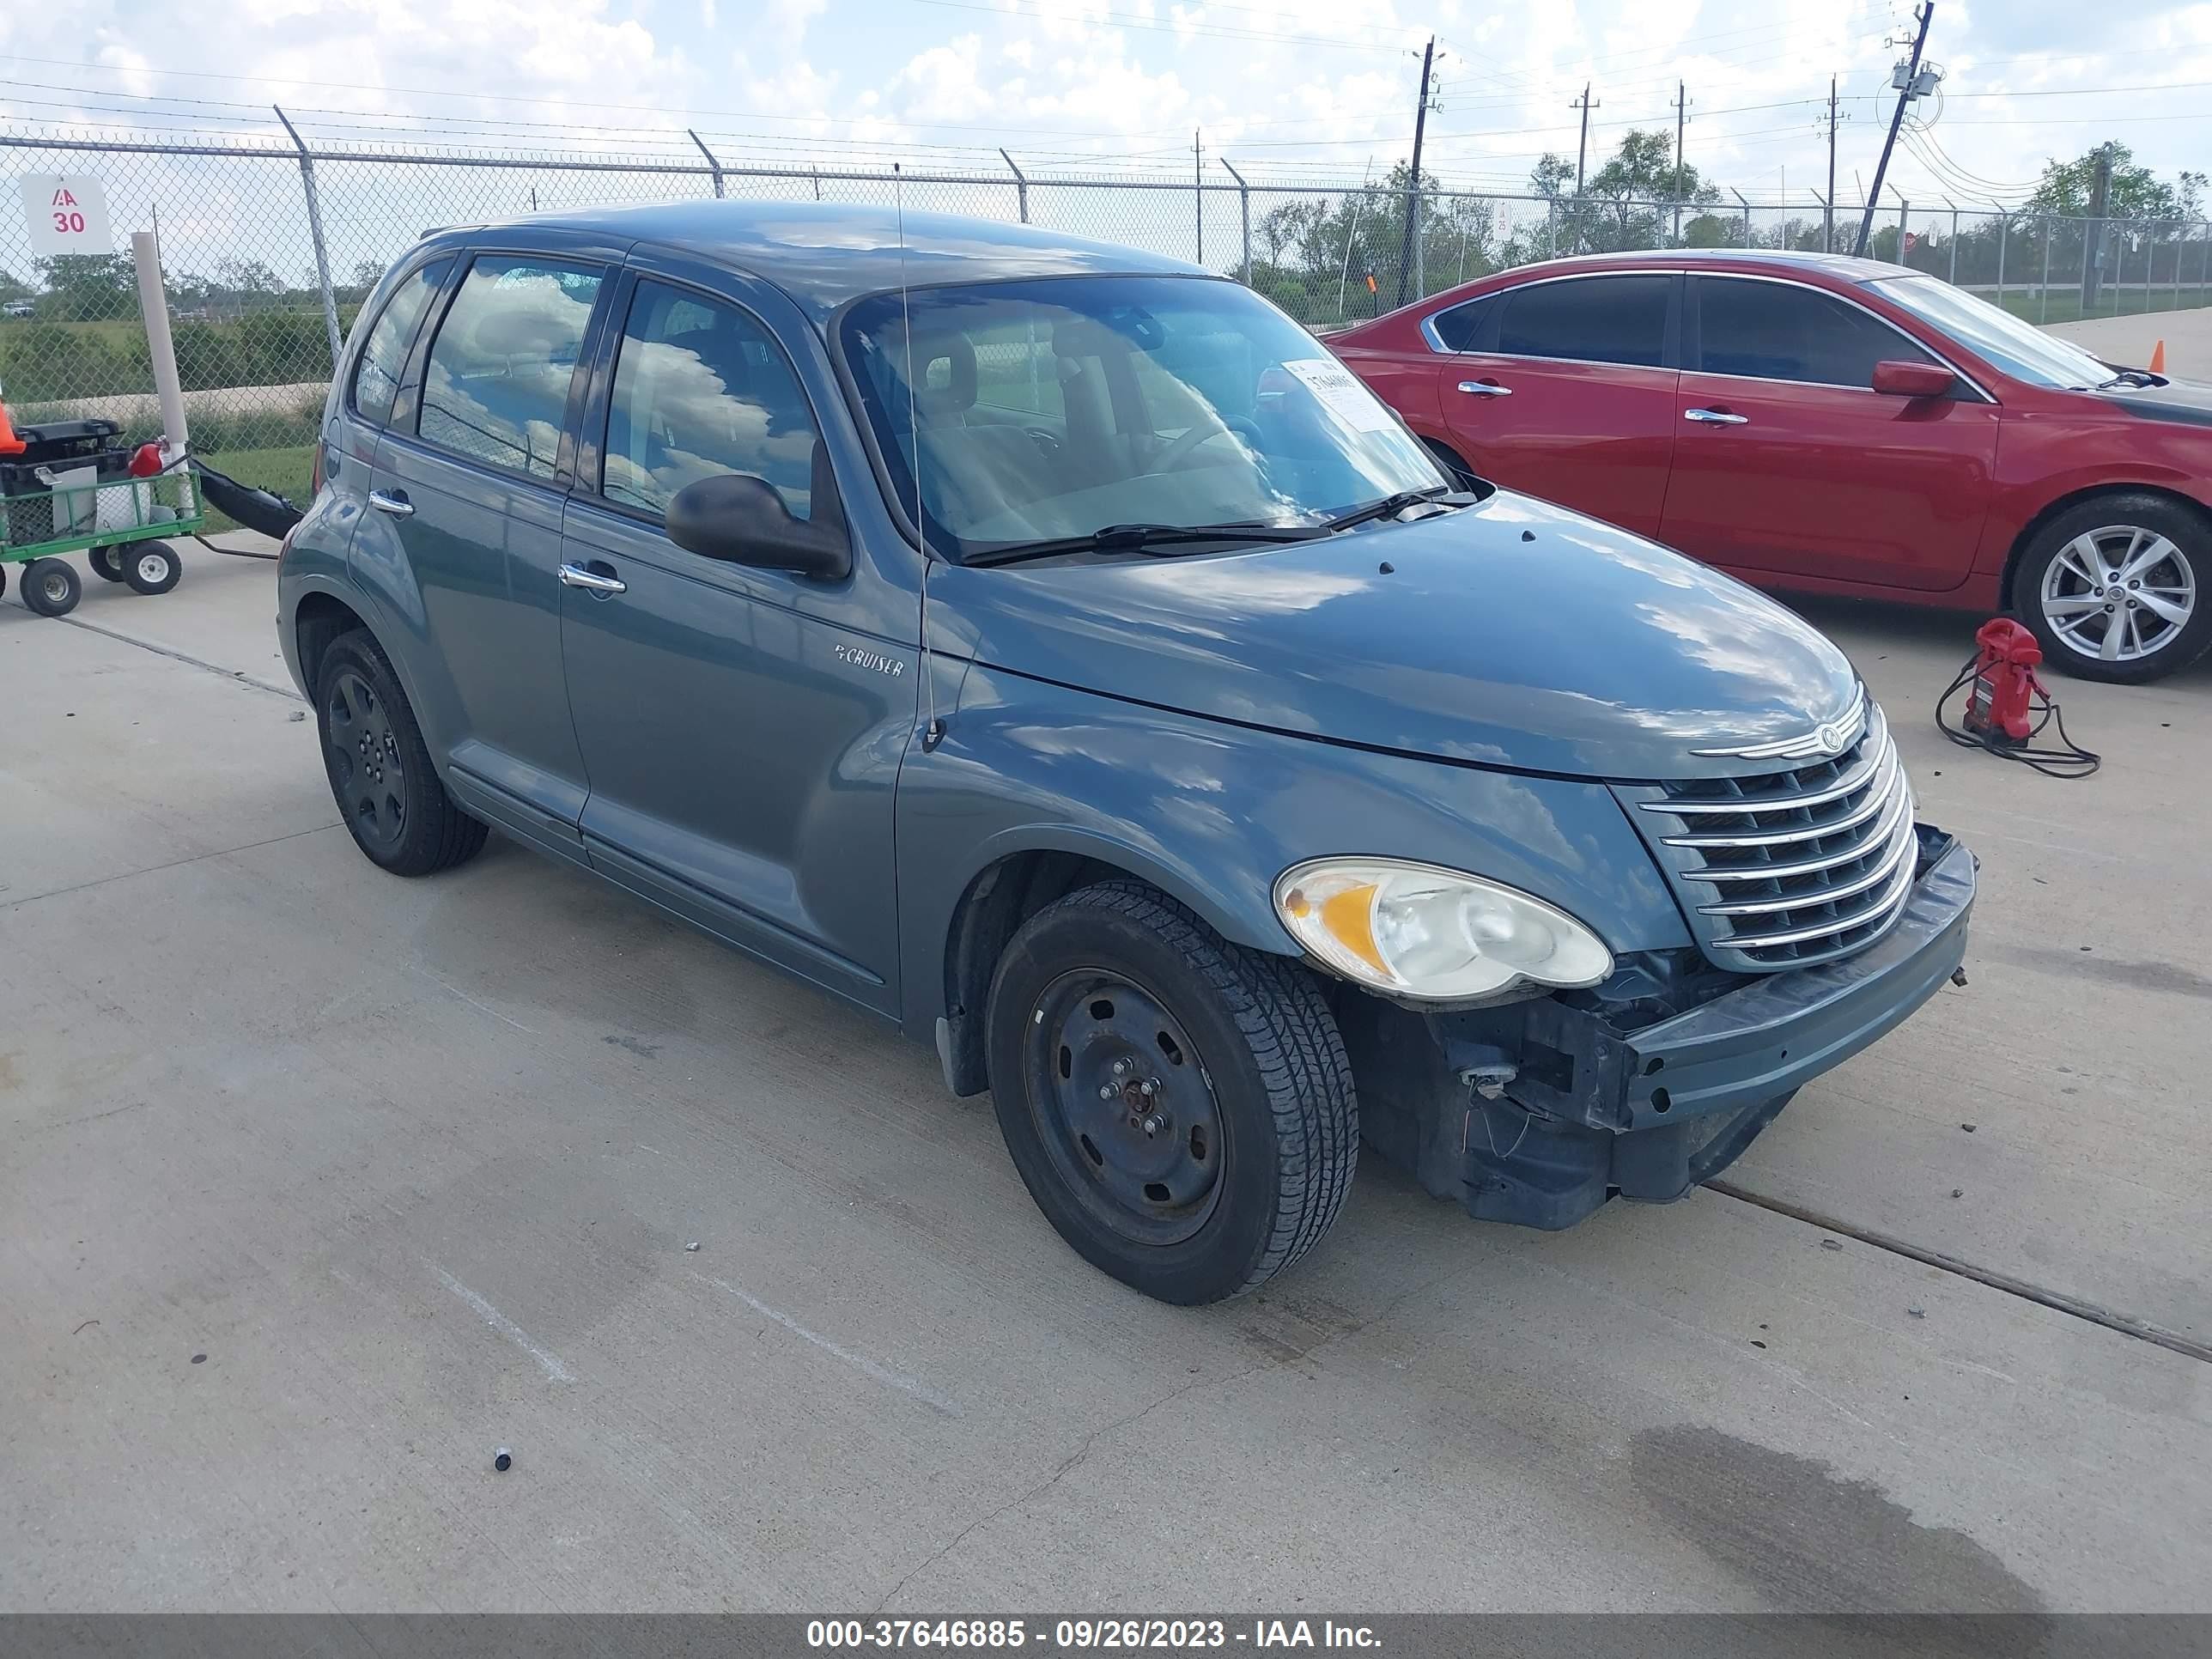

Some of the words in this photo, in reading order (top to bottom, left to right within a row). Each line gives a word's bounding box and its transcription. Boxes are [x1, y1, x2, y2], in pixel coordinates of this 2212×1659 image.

[53, 212, 84, 233] 30
[1498, 220, 1506, 230] 25
[1306, 374, 1356, 390] 37646
[847, 648, 904, 677] CRUISER
